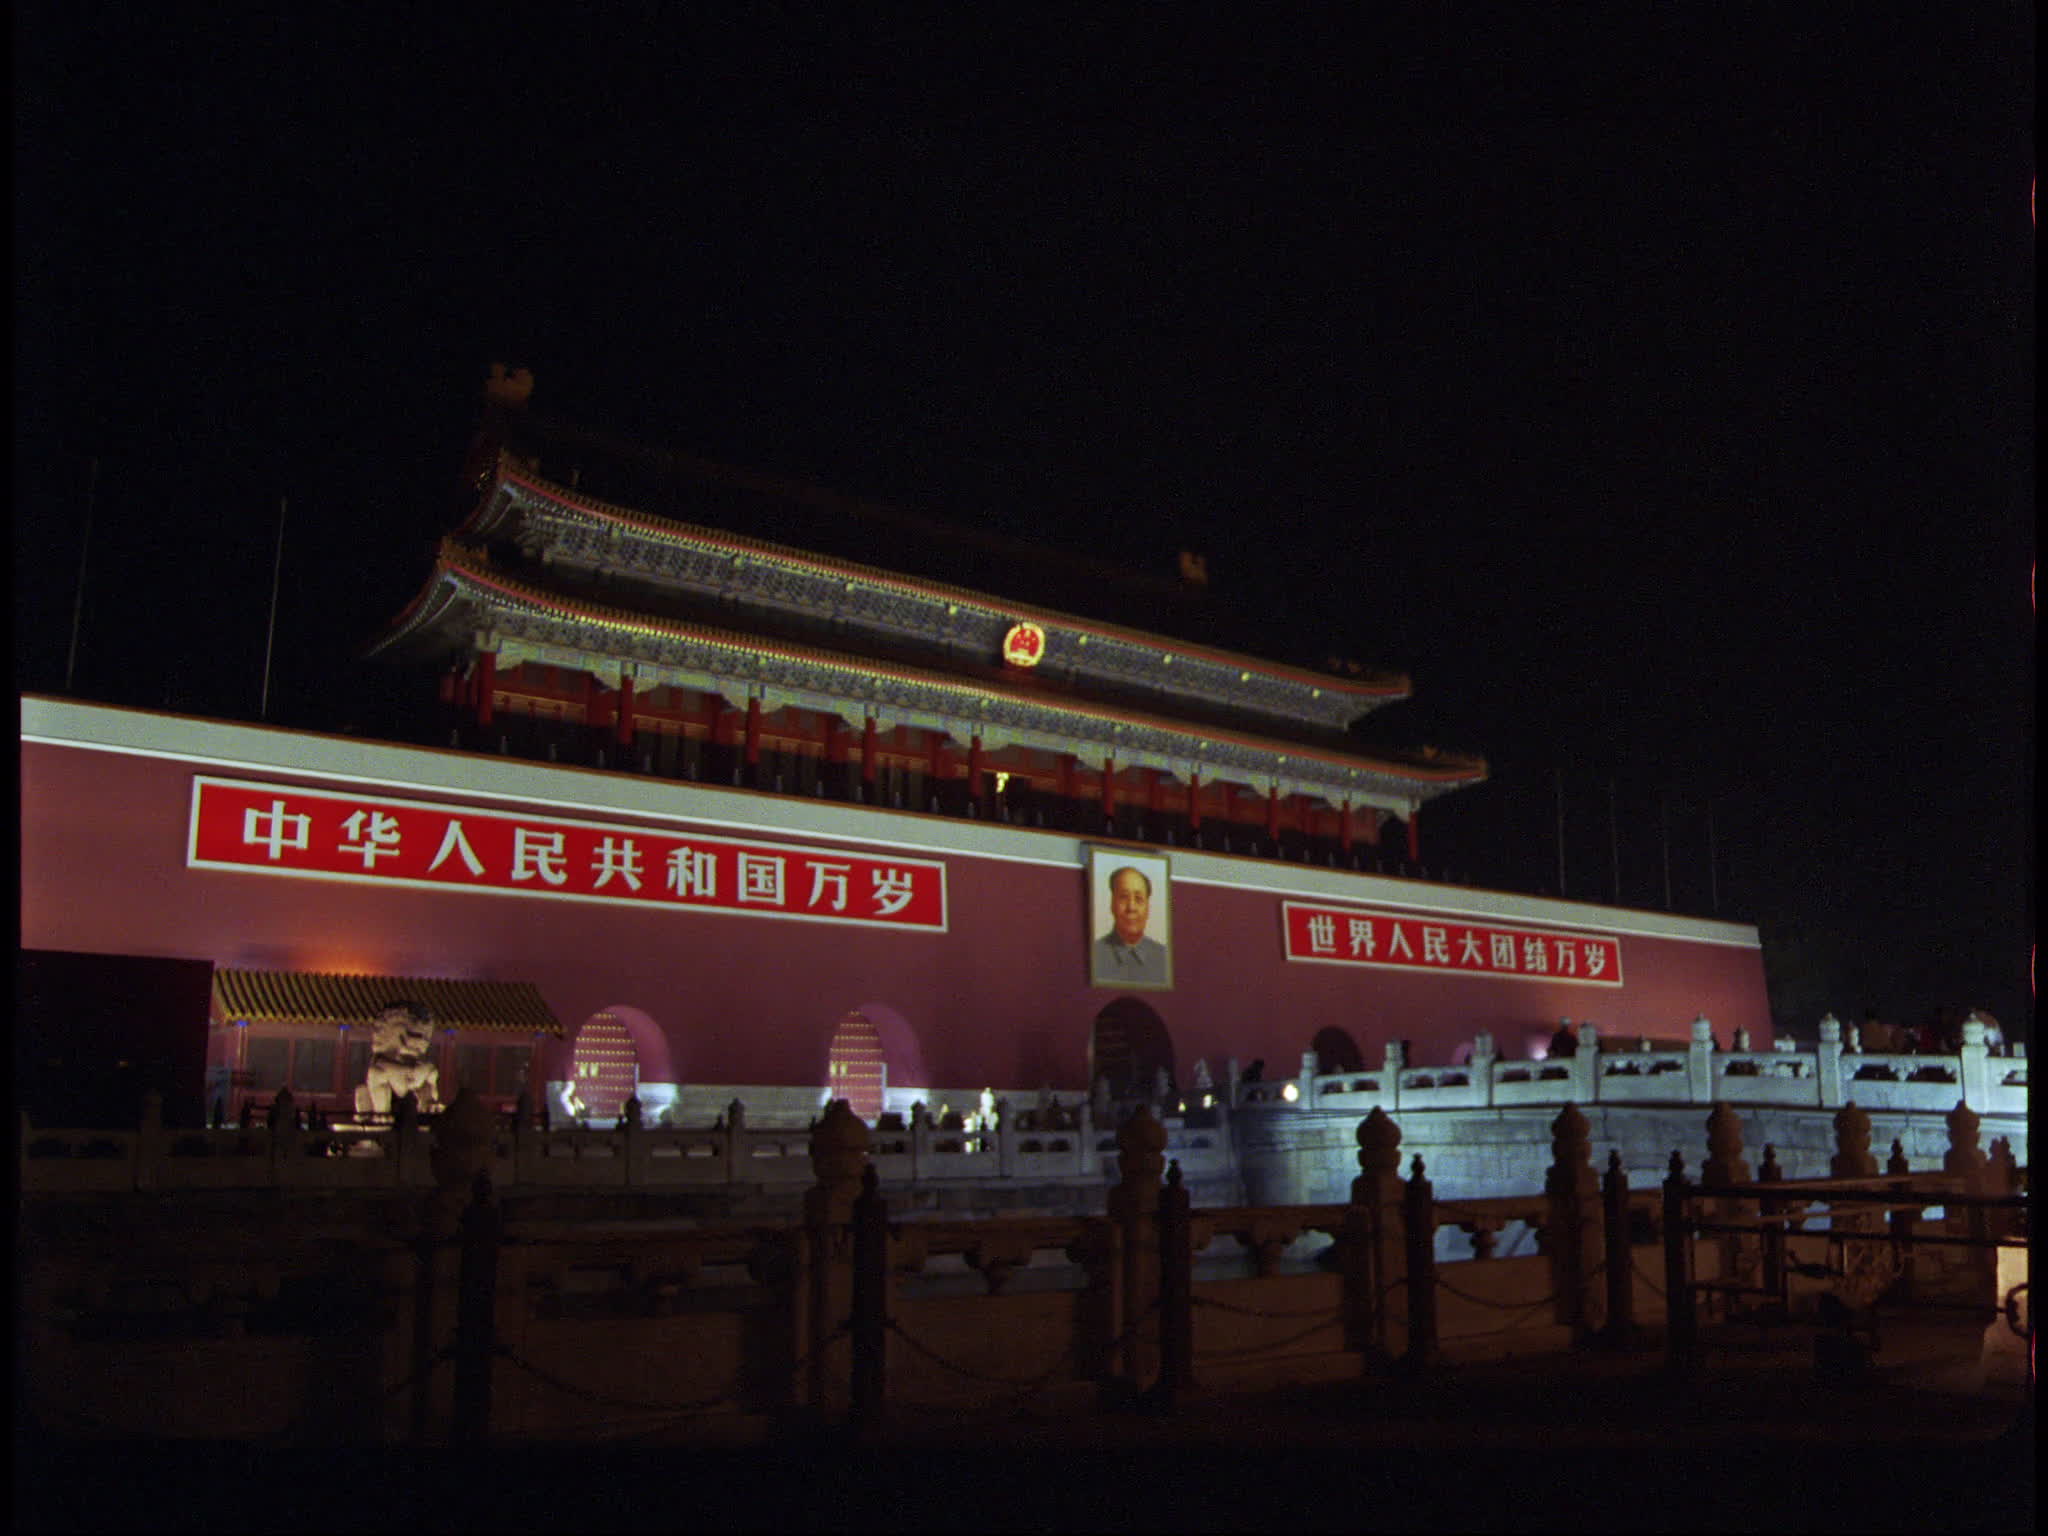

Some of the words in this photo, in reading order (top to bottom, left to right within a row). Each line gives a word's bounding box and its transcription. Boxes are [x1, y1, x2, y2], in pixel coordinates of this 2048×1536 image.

[243, 800, 914, 914] 中华人民共和国万岁
[1308, 914, 1605, 976] 世界人民大团结万岁
